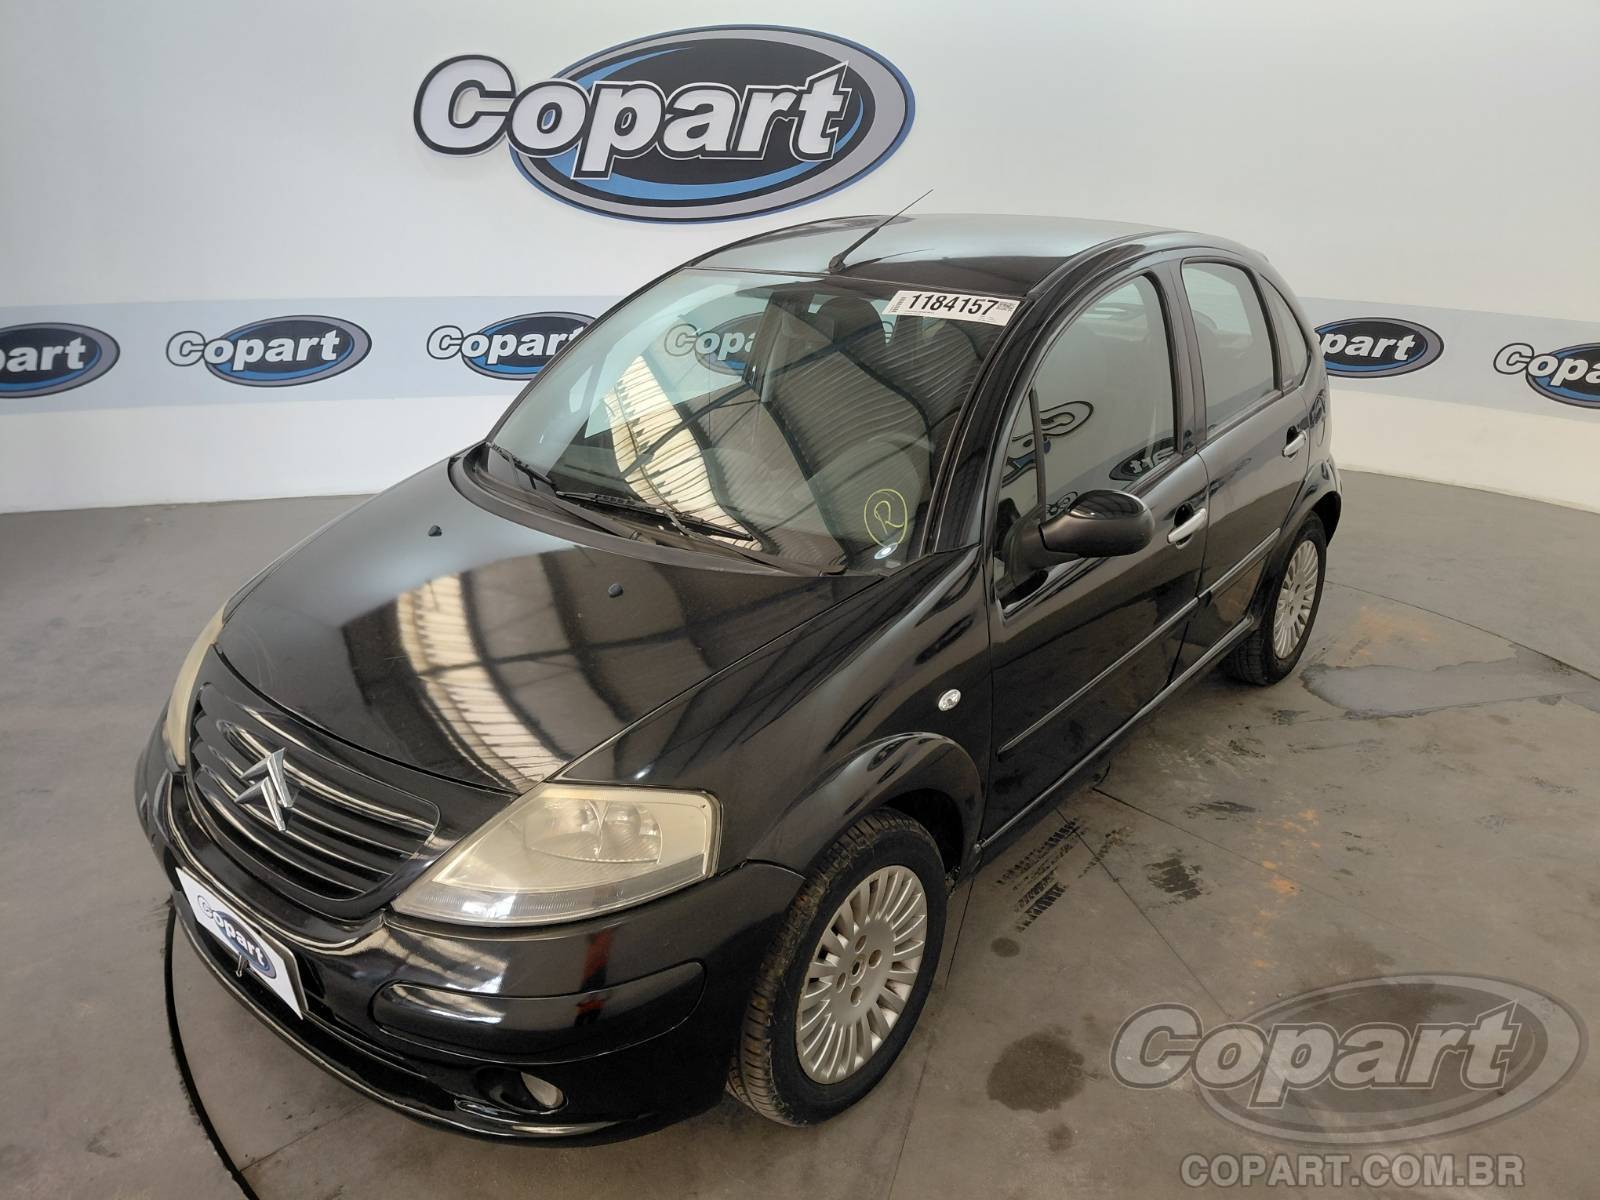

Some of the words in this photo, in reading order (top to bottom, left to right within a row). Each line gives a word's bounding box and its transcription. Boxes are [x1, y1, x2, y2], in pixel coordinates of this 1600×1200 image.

[413, 54, 853, 179] Copart
[909, 293, 999, 315] 1184157
[0, 336, 87, 373] art
[167, 329, 340, 371] Copart
[664, 323, 757, 361] Cop
[1313, 333, 1416, 361] part
[197, 894, 266, 967] Copart
